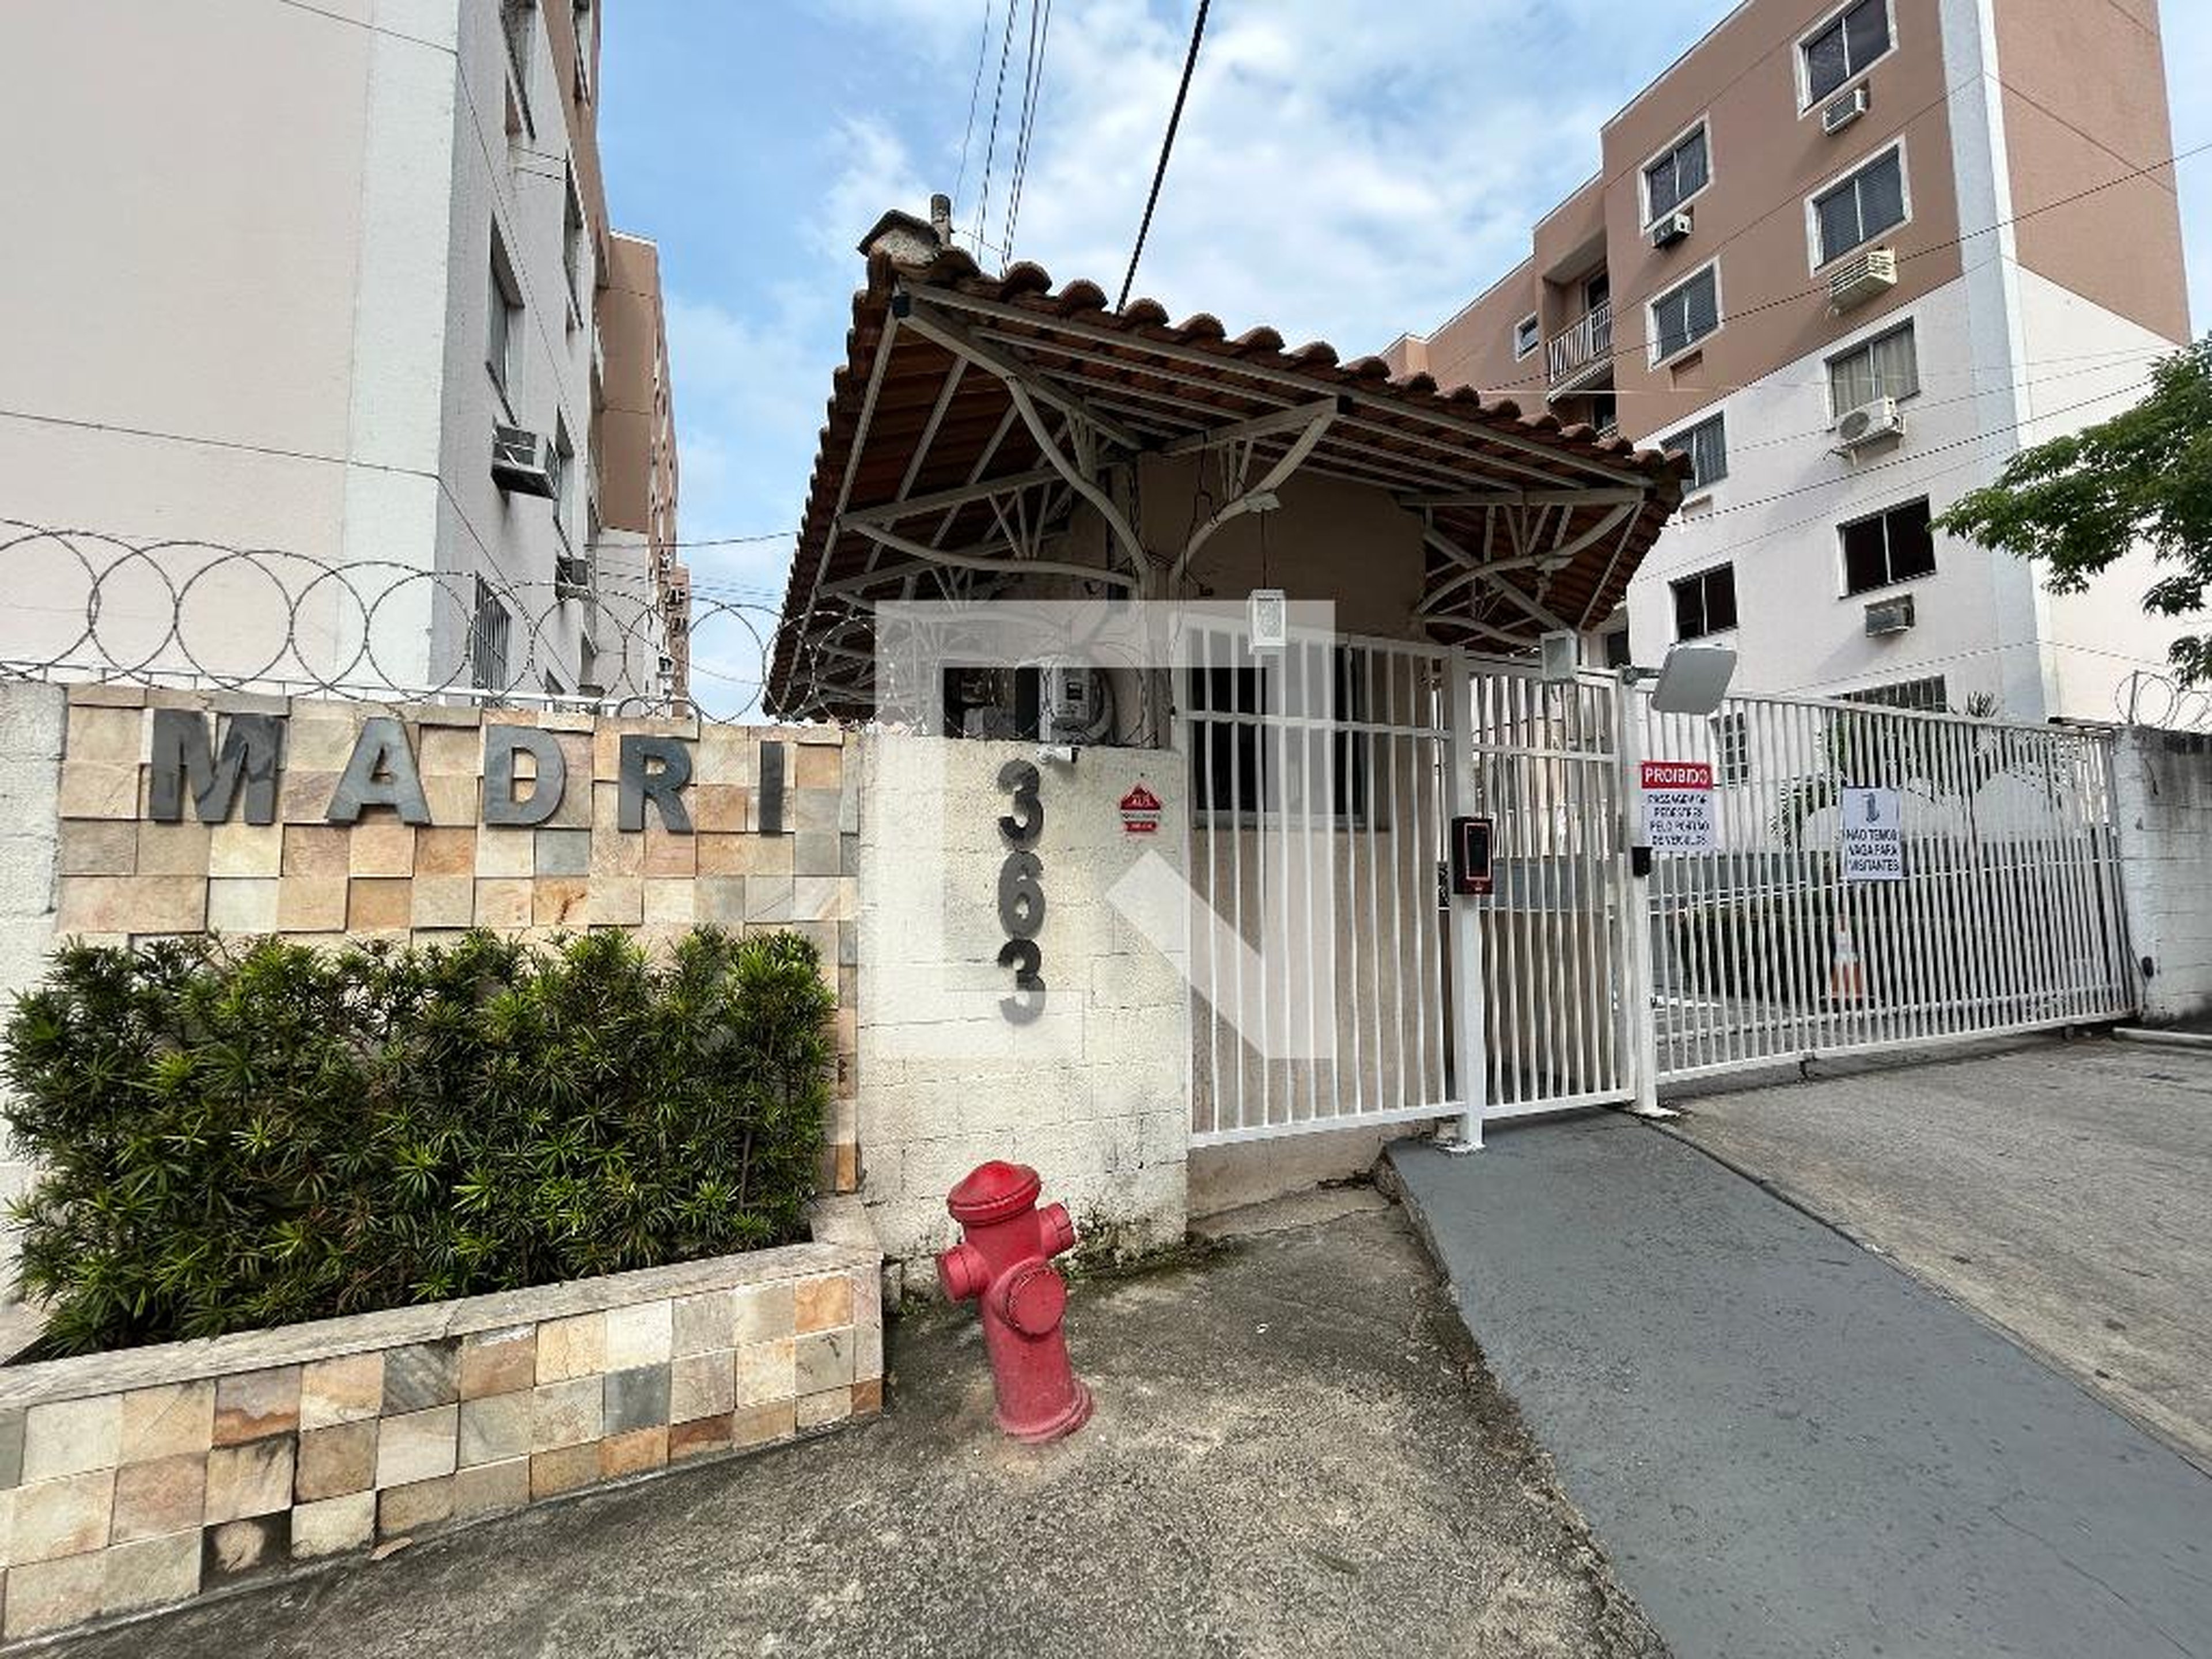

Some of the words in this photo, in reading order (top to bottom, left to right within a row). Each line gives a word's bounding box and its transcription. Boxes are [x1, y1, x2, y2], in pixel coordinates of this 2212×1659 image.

[149, 709, 785, 836] MADRI
[1645, 767, 1708, 785] PROIBIDO
[997, 759, 1046, 1025] 363
